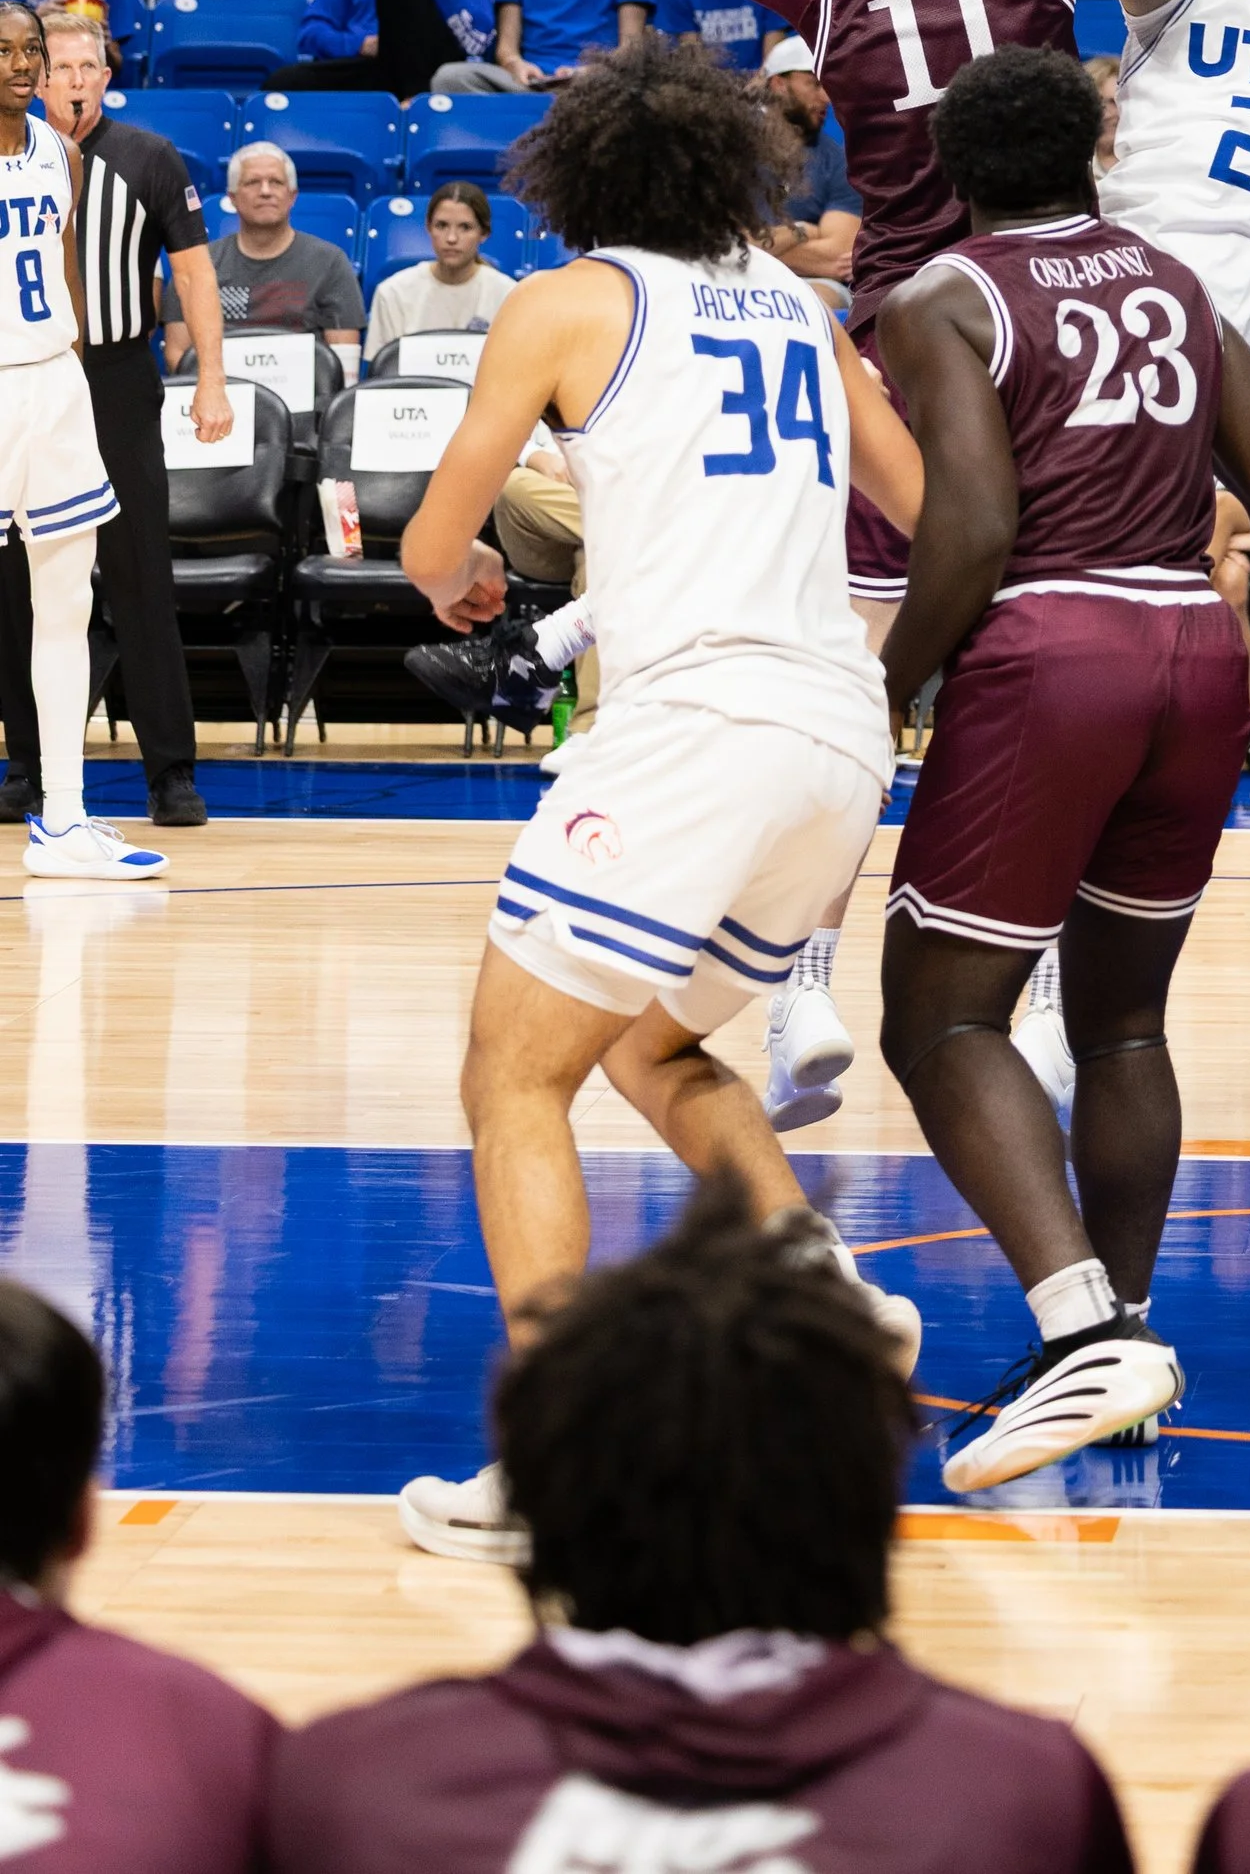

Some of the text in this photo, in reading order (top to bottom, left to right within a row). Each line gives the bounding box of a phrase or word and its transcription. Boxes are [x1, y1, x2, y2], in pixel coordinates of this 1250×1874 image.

[16, 248, 52, 322] 8
[1029, 246, 1154, 289] OSEI-BONSU
[691, 282, 808, 326] JACKSON
[245, 353, 278, 367] UTA
[436, 353, 470, 366] UTA
[1055, 286, 1198, 428] 23
[393, 407, 428, 421] UTA
[692, 333, 836, 489] 34
